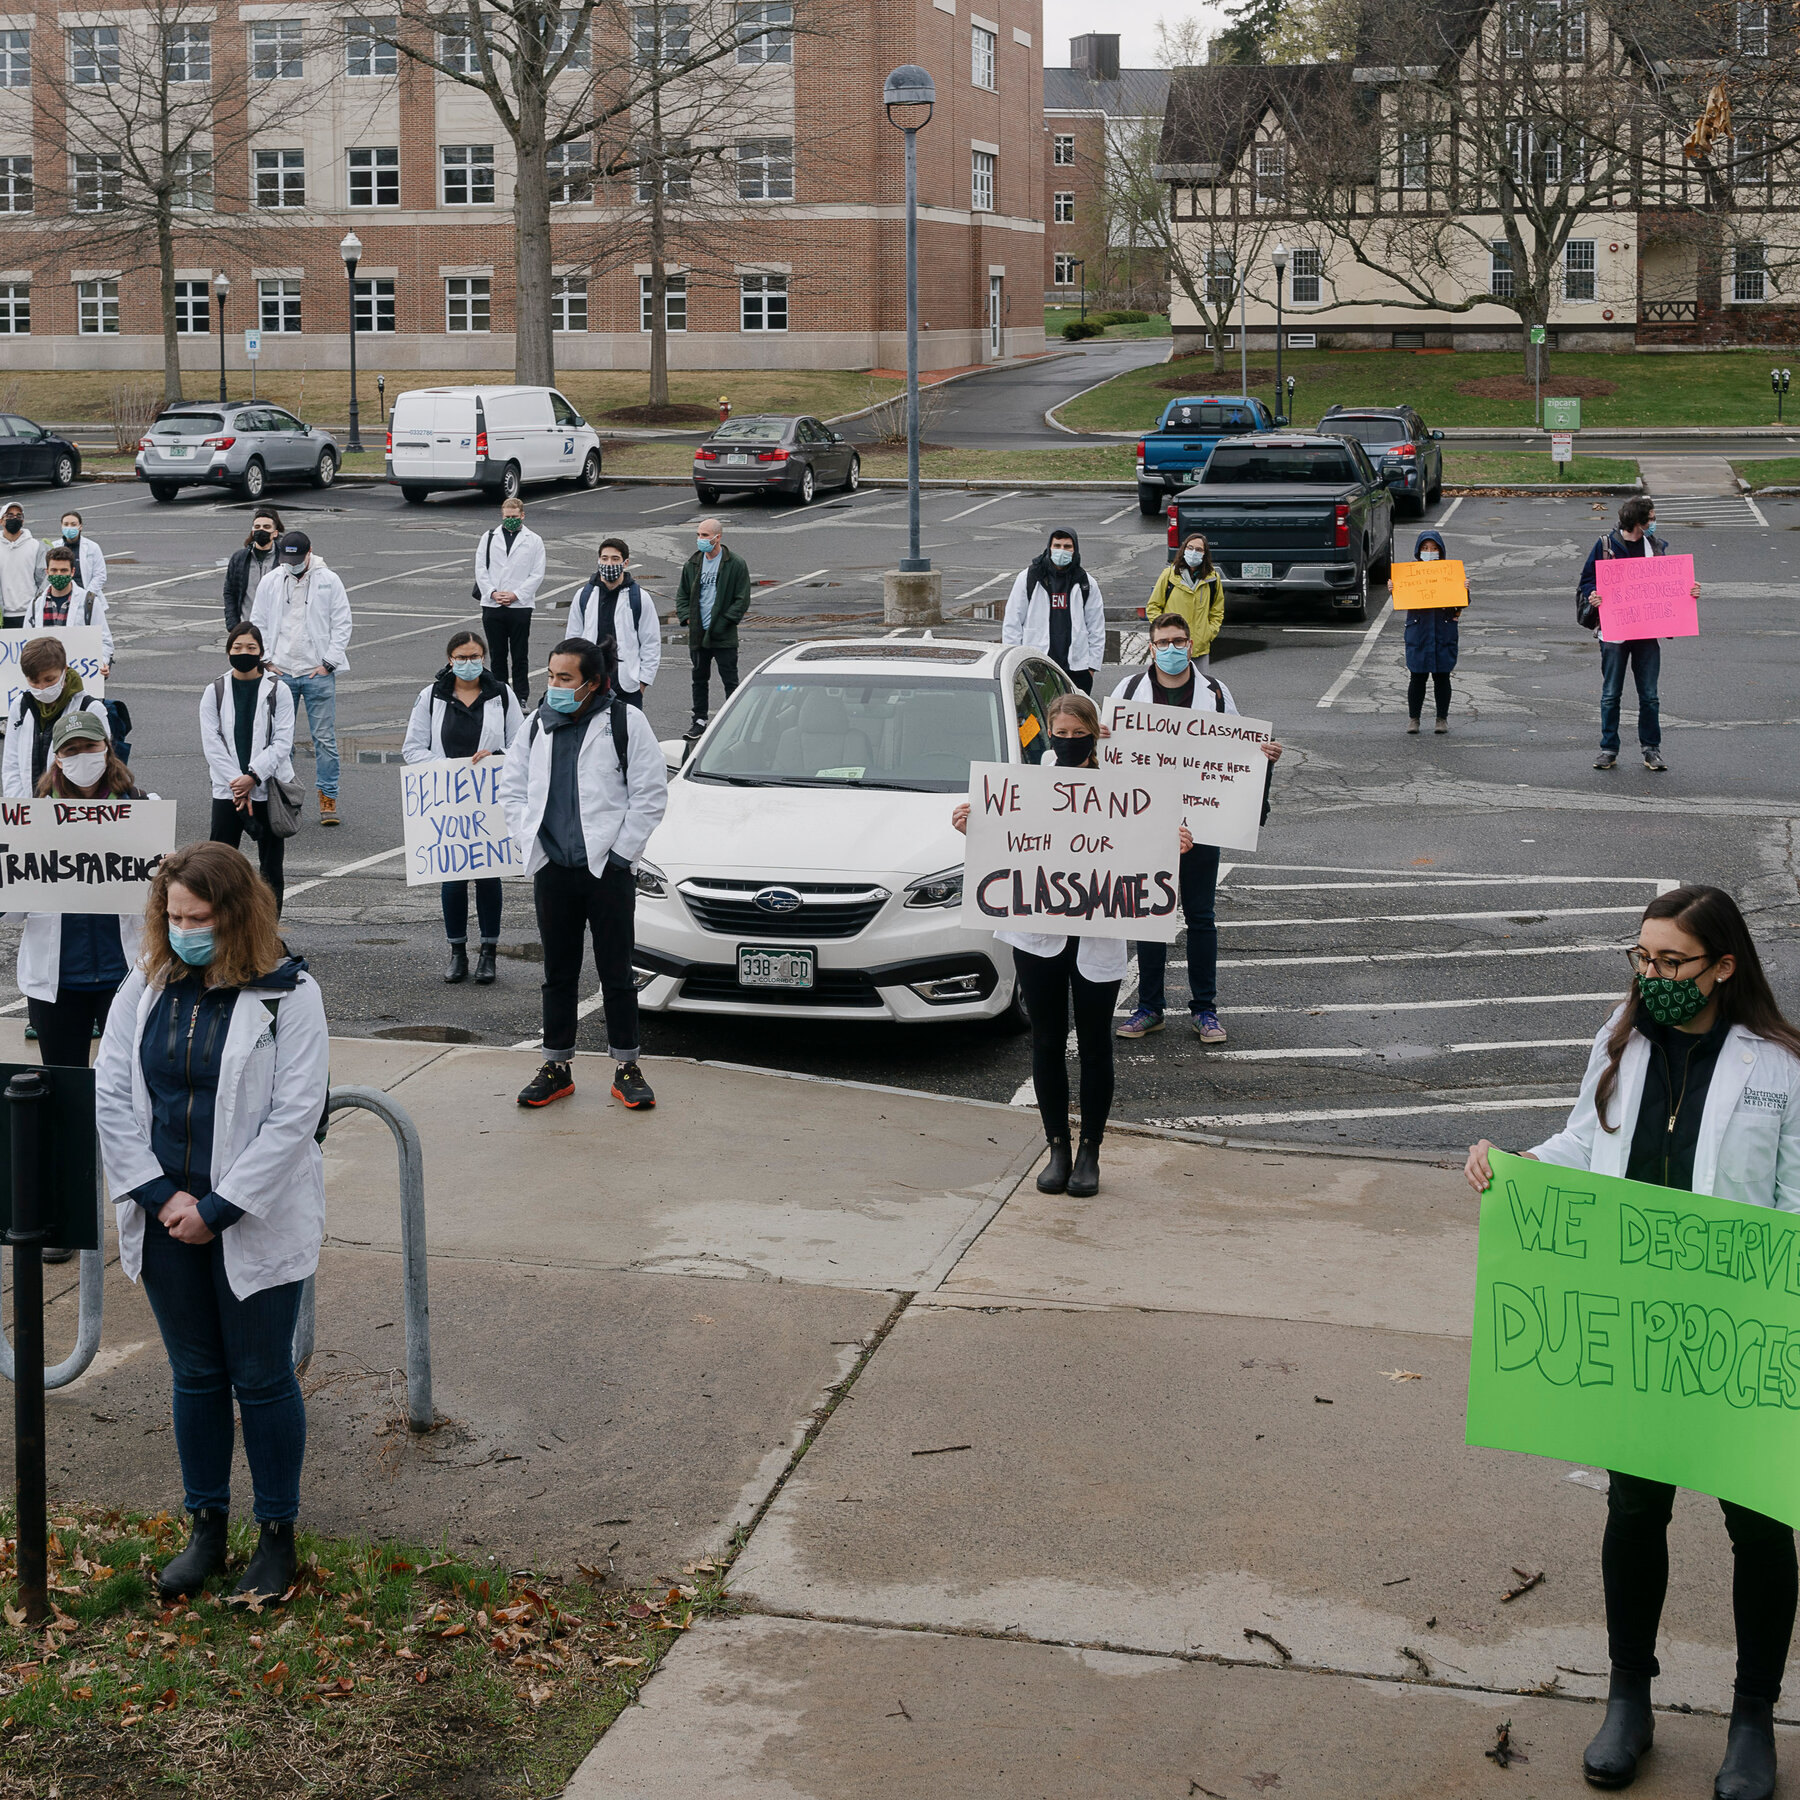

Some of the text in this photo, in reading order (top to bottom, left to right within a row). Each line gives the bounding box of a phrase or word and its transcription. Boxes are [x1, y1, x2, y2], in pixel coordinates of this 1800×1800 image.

[1547, 398, 1577, 409] zipcars
[1112, 705, 1269, 744] FELLOW CLASSMATES
[1104, 745, 1123, 765] WE
[1131, 751, 1151, 766] SEE
[1183, 756, 1200, 769] WE
[1203, 761, 1224, 773] ARE
[1227, 762, 1251, 773] HERE
[405, 765, 504, 817] BELIEVE
[1201, 772, 1216, 782] FOR
[984, 774, 1152, 819] WE STAND
[1183, 793, 1221, 809] HTING
[2, 802, 132, 826] WE DESERVE
[429, 810, 491, 844] YOUR
[1007, 831, 1114, 853] WITH OUR
[0, 843, 164, 889] TRANSPARENC
[976, 865, 1177, 921] CLASSMATES
[743, 958, 771, 976] 338
[758, 976, 795, 984] COLORADO
[1744, 1086, 1788, 1101] Dartmouth
[1506, 1179, 1596, 1259] WE
[1492, 1281, 1800, 1410] DUE PROCES
